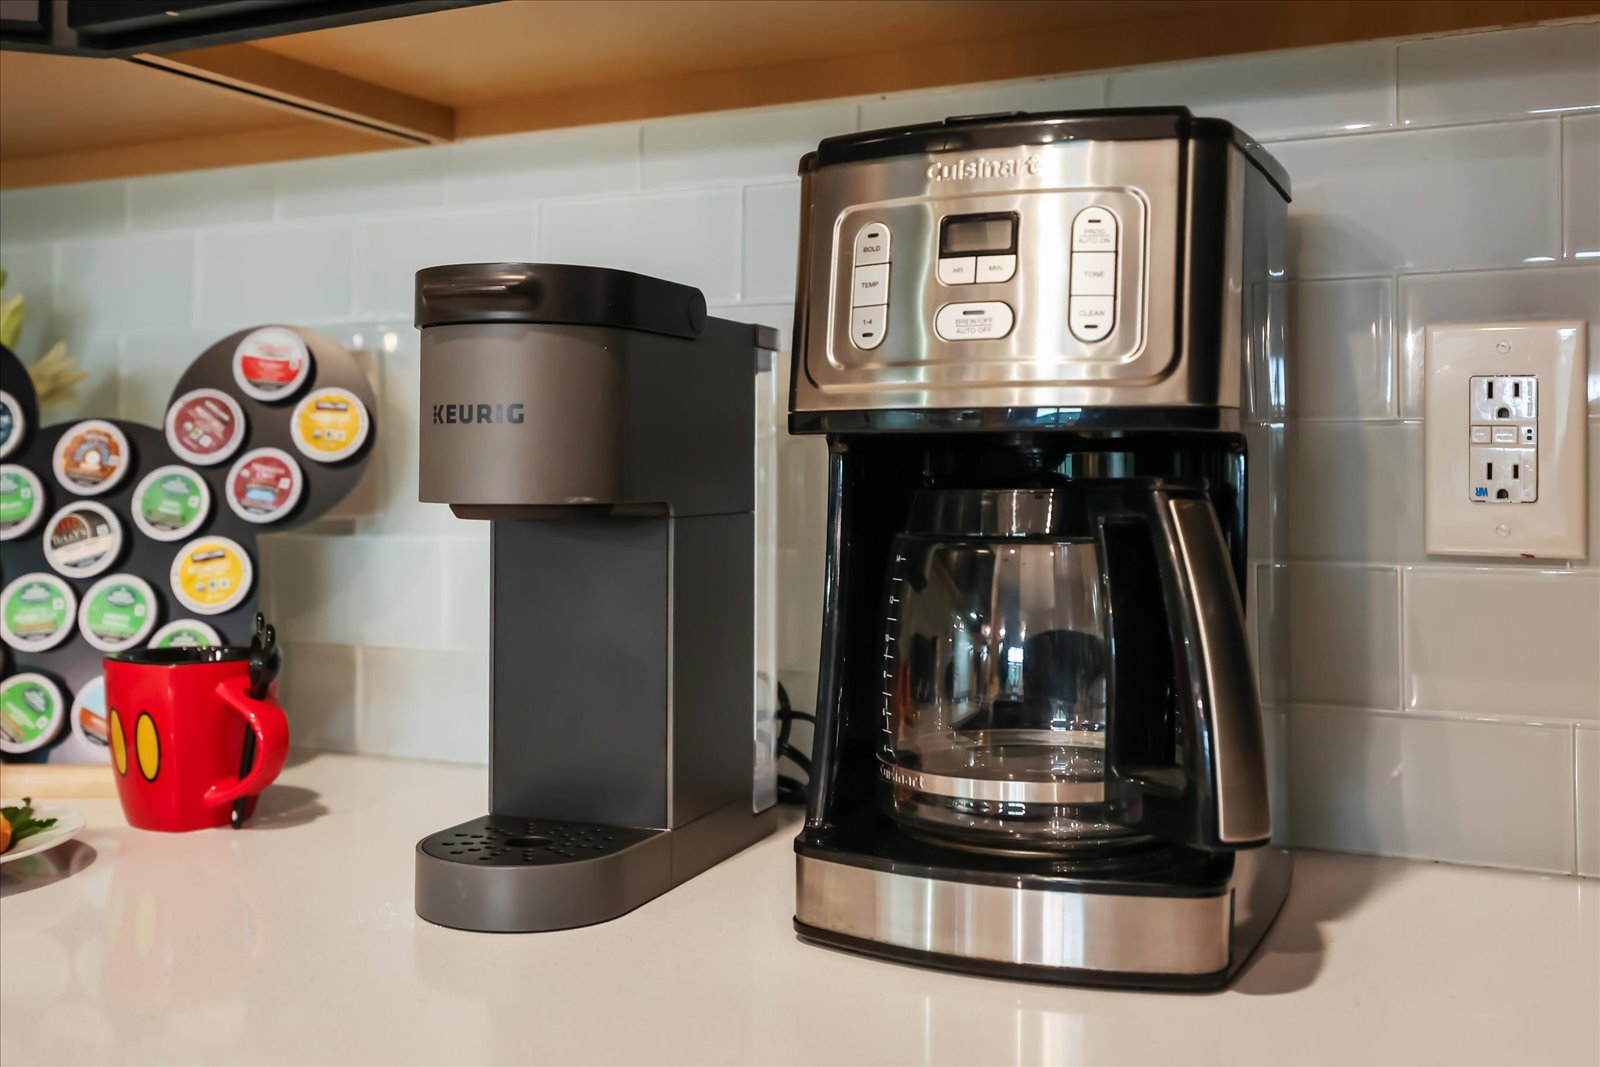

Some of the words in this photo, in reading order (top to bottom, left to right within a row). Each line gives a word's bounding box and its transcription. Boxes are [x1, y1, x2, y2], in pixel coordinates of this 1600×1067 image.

[927, 154, 1041, 182] Cuisinart
[1078, 236, 1098, 244] AUTO
[863, 245, 881, 253] BOLD
[988, 264, 1004, 272] MIN
[1083, 270, 1105, 278] TONE
[1078, 308, 1106, 318] CLEAN
[863, 318, 873, 326] 1-4
[956, 326, 977, 335] AUTO
[978, 326, 993, 334] OFF
[432, 403, 525, 425] KEURIG
